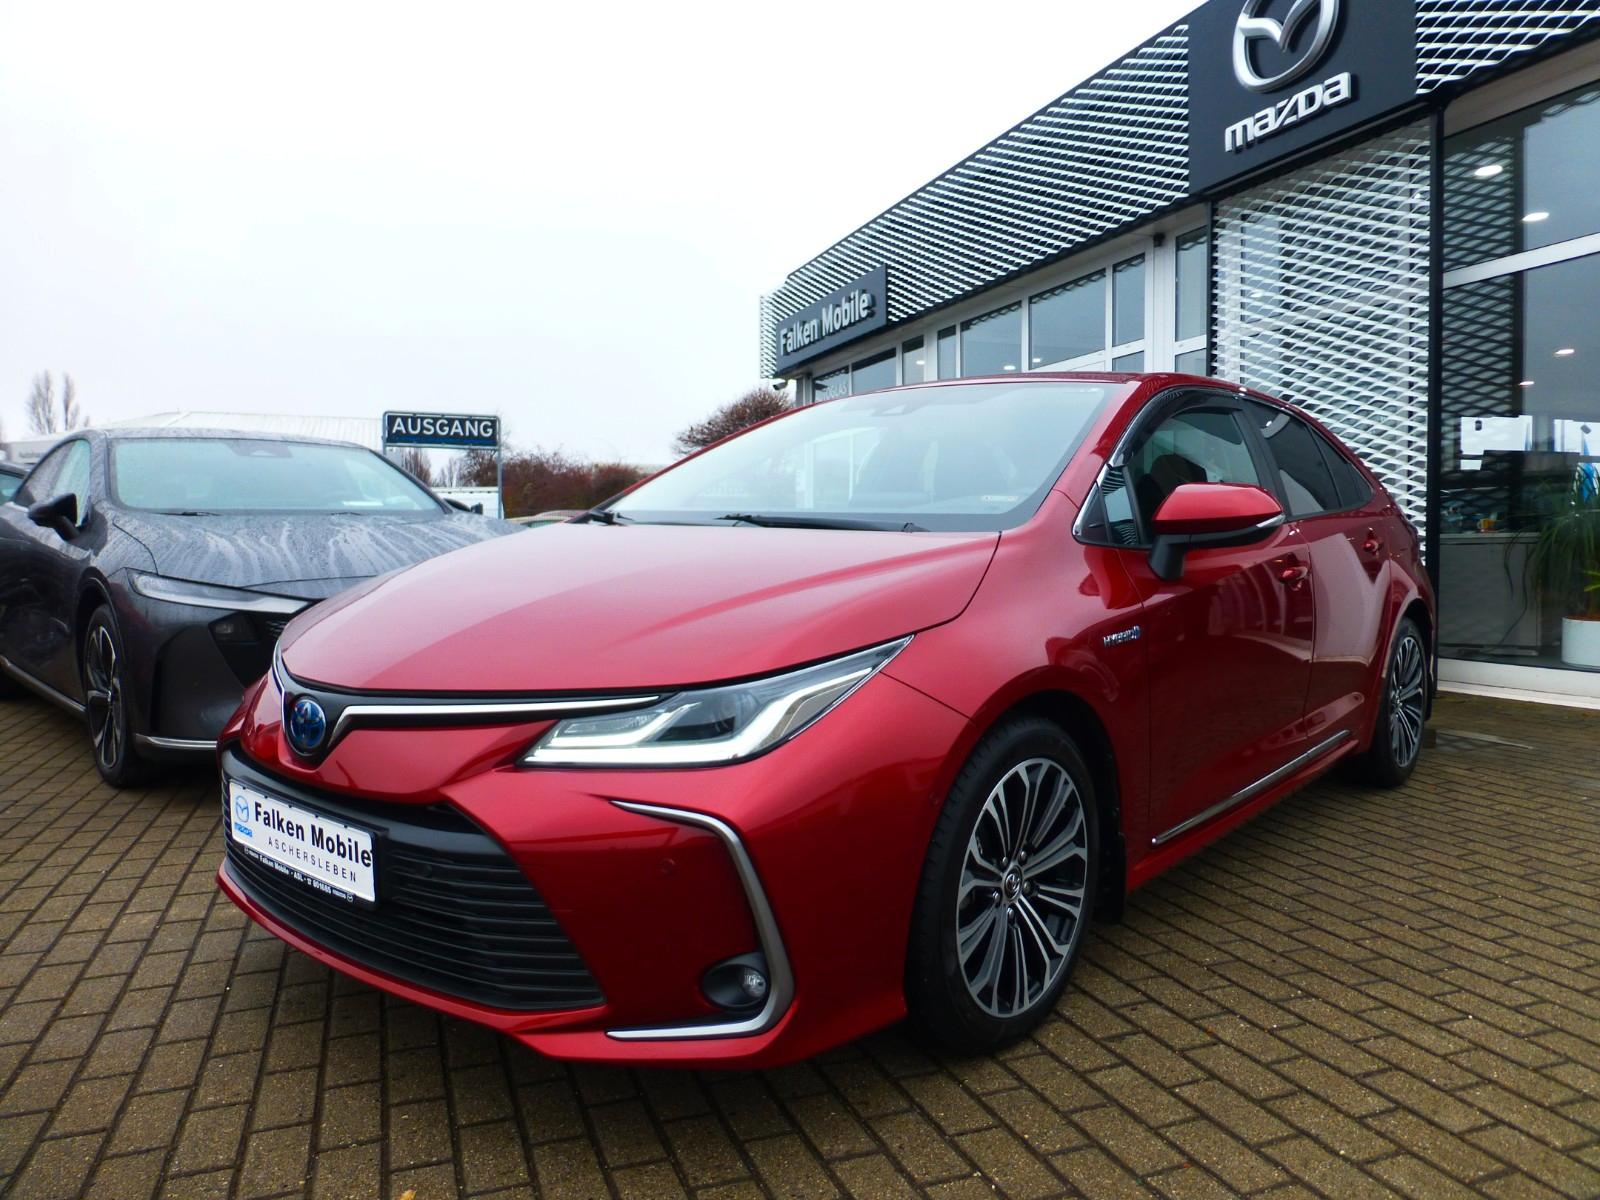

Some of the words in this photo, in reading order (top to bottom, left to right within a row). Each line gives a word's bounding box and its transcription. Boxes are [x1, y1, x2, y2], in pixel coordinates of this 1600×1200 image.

[1225, 71, 1351, 152] mazda
[780, 318, 819, 356] Falken
[822, 288, 871, 336] Mobile
[392, 417, 493, 437] AUSGANG
[254, 801, 305, 842] Falken
[310, 823, 372, 868] Mobile
[268, 836, 357, 883] ASCHERSLEBEN
